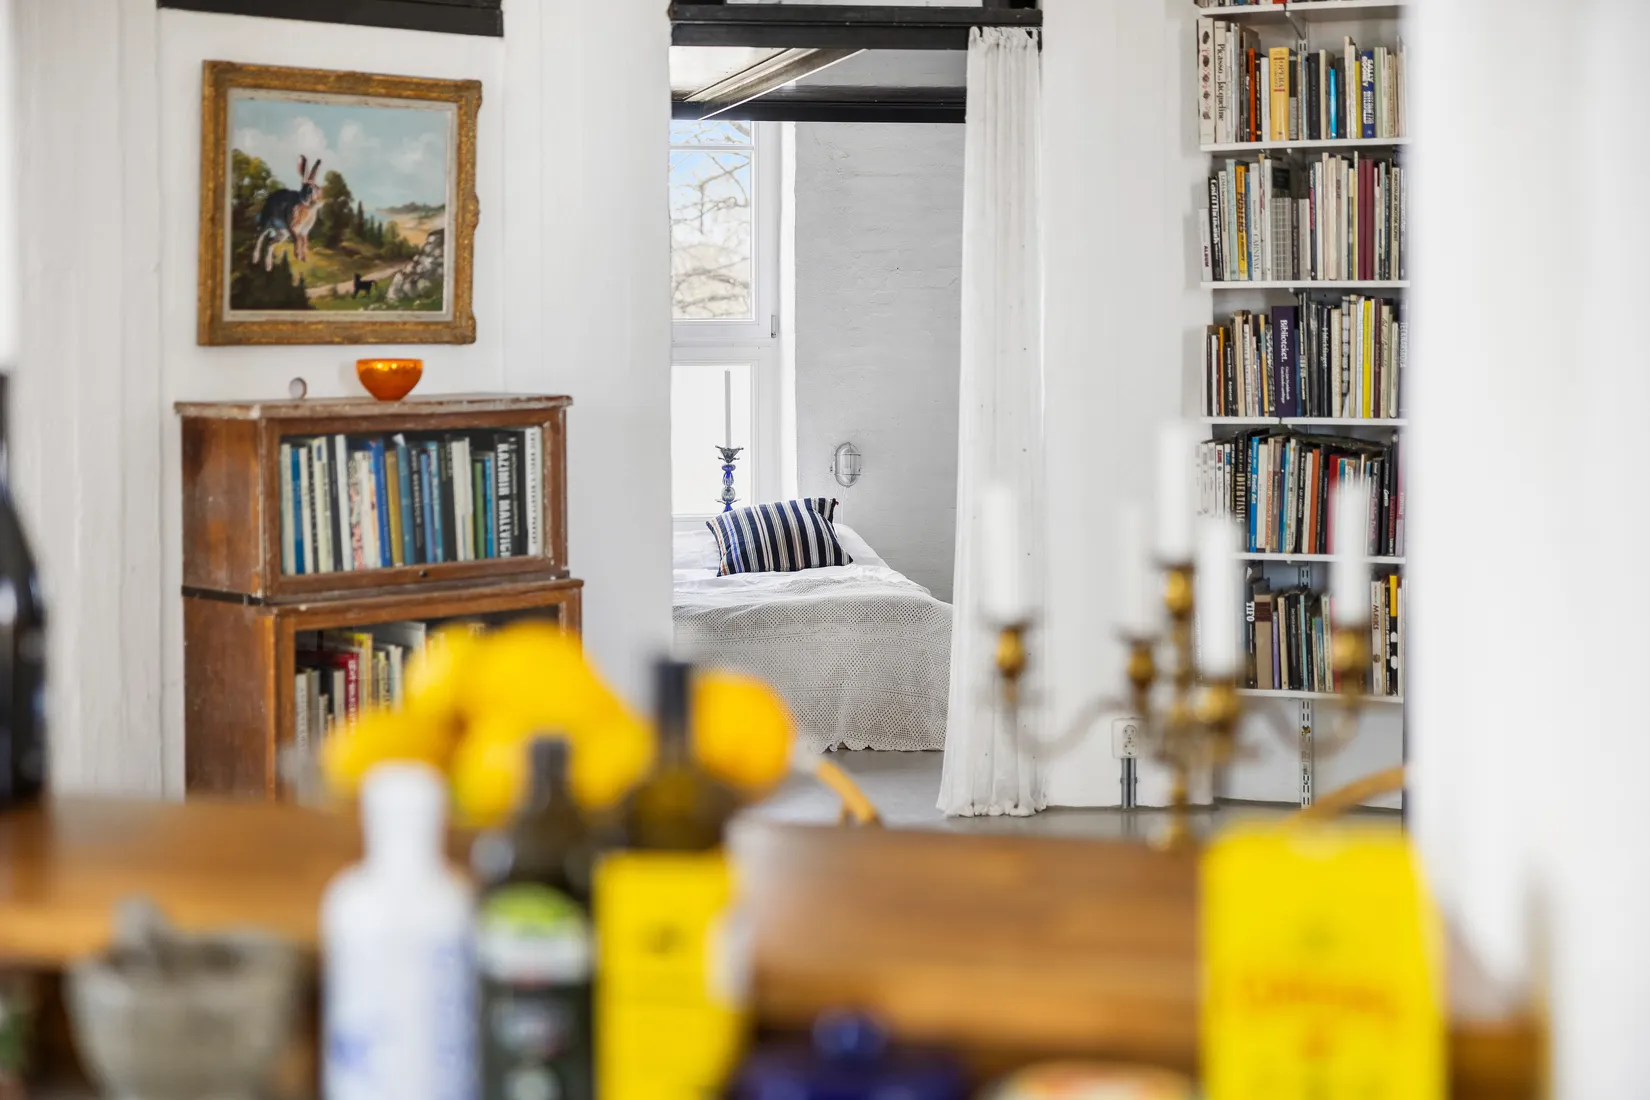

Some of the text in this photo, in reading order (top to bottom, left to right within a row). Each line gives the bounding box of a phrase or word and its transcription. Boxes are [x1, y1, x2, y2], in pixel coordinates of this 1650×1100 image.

[1217, 44, 1225, 74] Picasso
[1216, 81, 1226, 121] Jacqueline
[497, 444, 510, 496] KAZIMIR
[1246, 601, 1254, 622] TIFO
